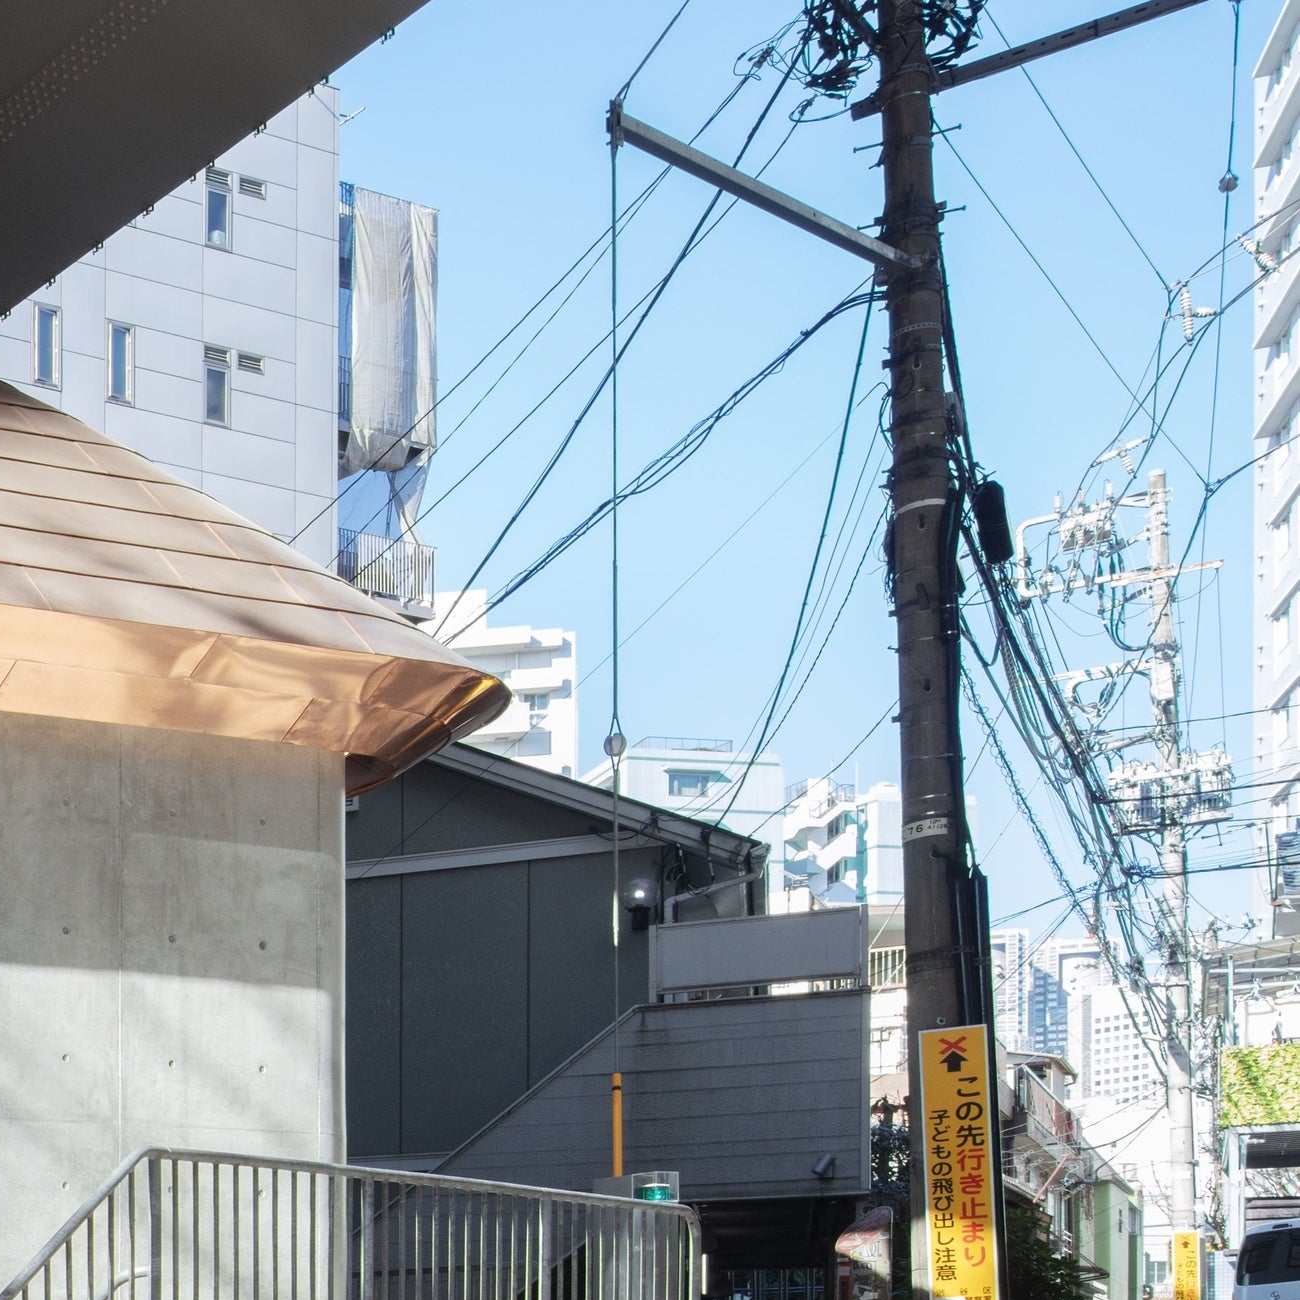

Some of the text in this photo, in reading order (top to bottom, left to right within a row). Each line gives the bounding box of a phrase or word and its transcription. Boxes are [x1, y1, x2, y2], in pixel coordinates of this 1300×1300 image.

[907, 824, 924, 836] 76
[929, 1109, 957, 1281] 子どもの飛び出し注意
[955, 1075, 988, 1268] この先行き止まり
